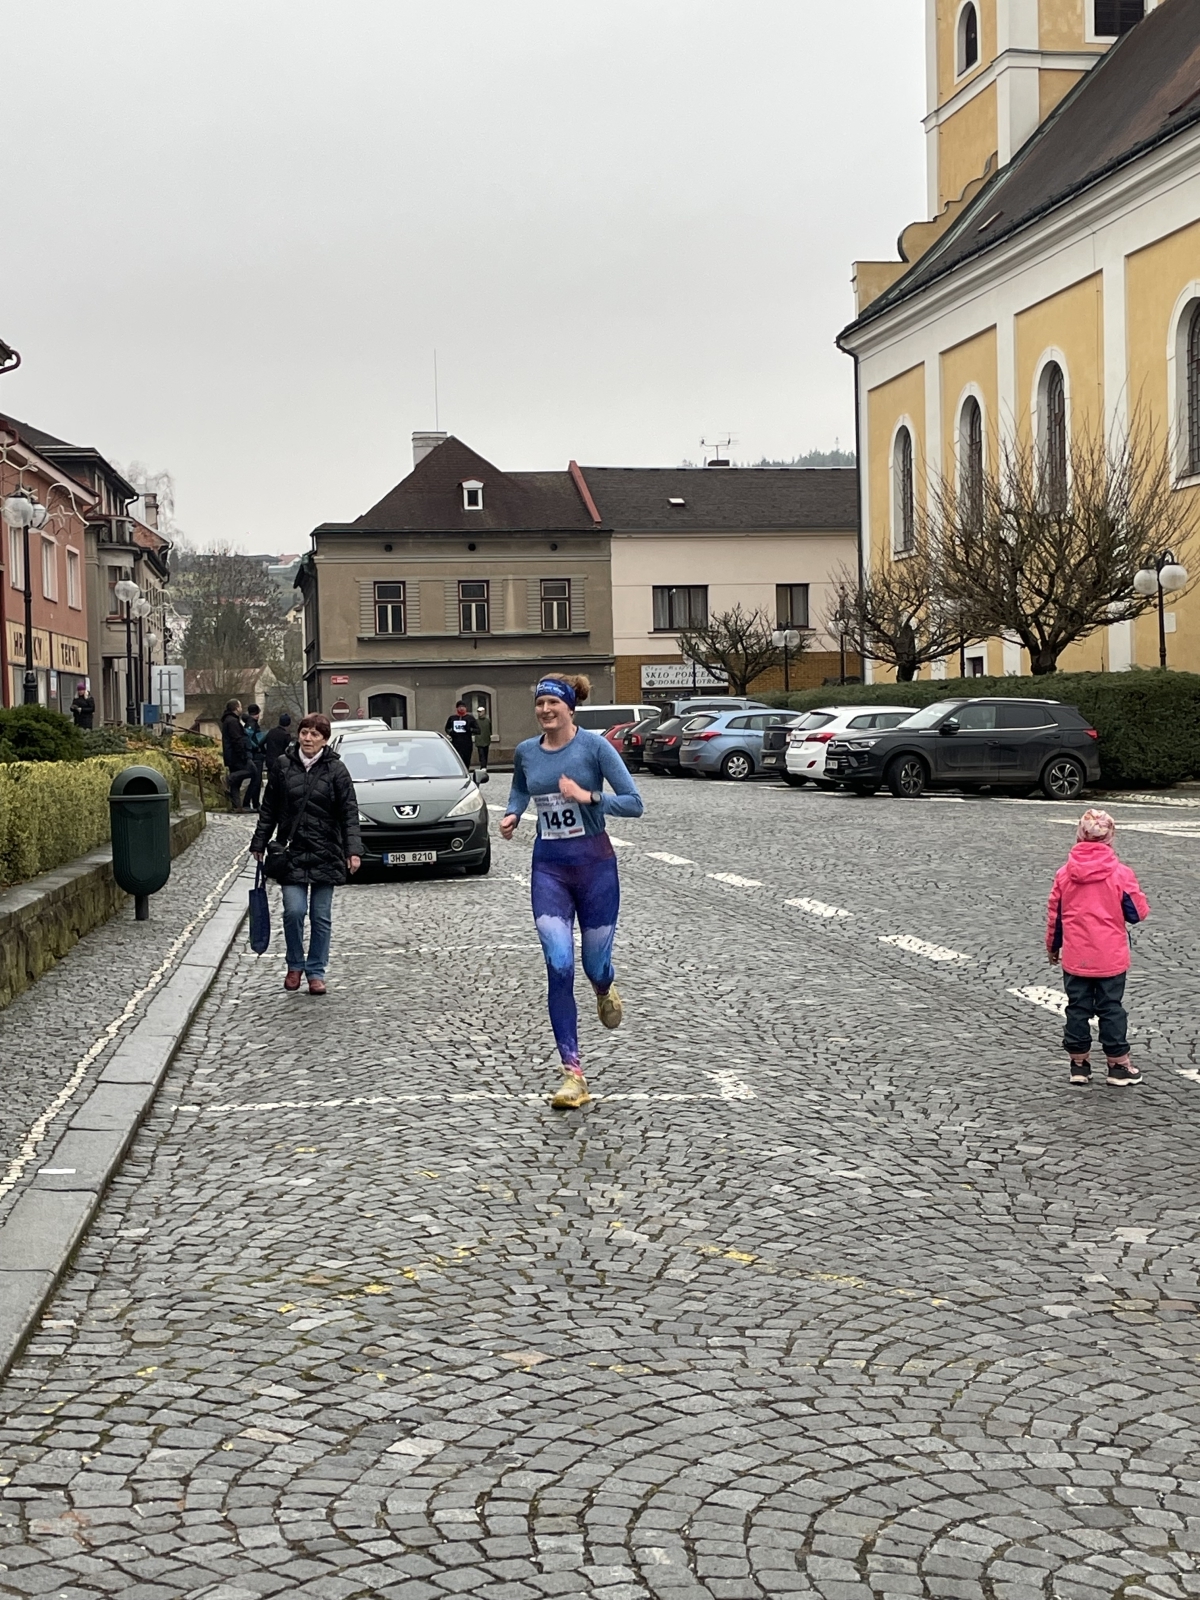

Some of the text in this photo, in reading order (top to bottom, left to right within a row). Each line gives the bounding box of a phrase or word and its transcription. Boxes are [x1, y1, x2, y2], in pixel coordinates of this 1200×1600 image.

[13, 632, 42, 661] HRKY
[61, 643, 80, 668] TEXTIL
[645, 671, 670, 679] SKLO
[542, 808, 577, 830] 148
[390, 852, 433, 863] 3H9 8210
